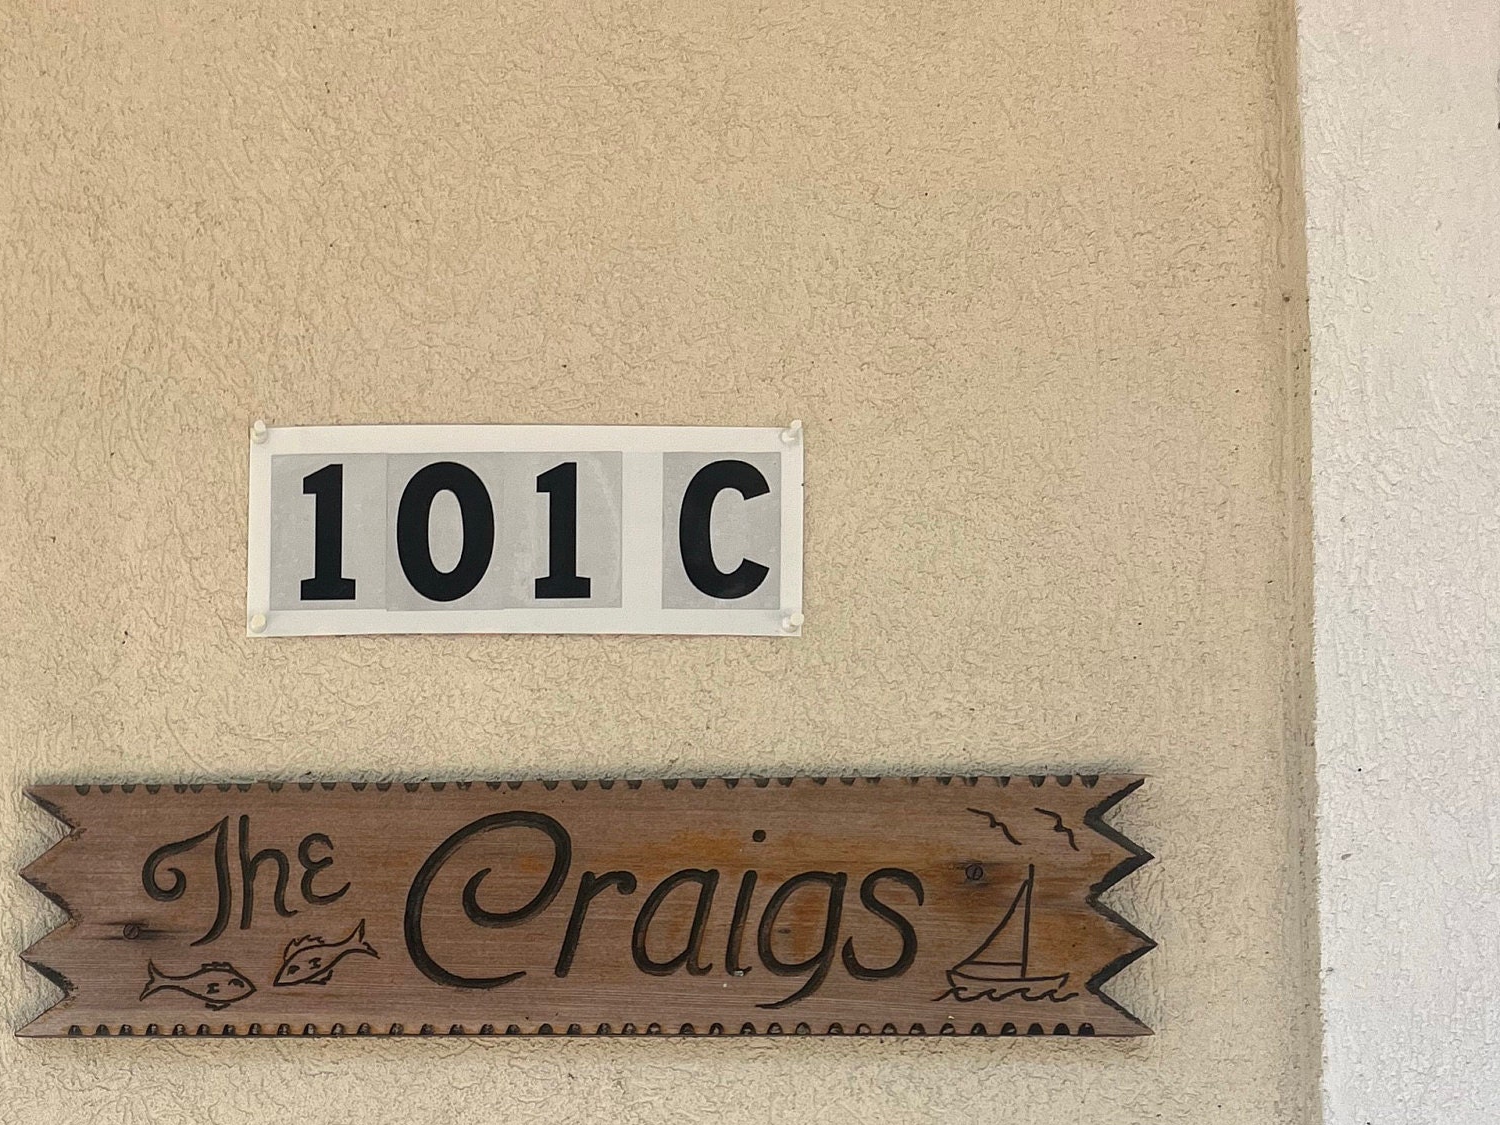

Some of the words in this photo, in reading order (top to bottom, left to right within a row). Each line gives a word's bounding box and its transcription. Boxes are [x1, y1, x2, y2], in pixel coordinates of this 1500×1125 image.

[299, 460, 592, 603] 101
[678, 458, 772, 600] C
[141, 813, 353, 948] The
[403, 809, 926, 1010] Craigs
